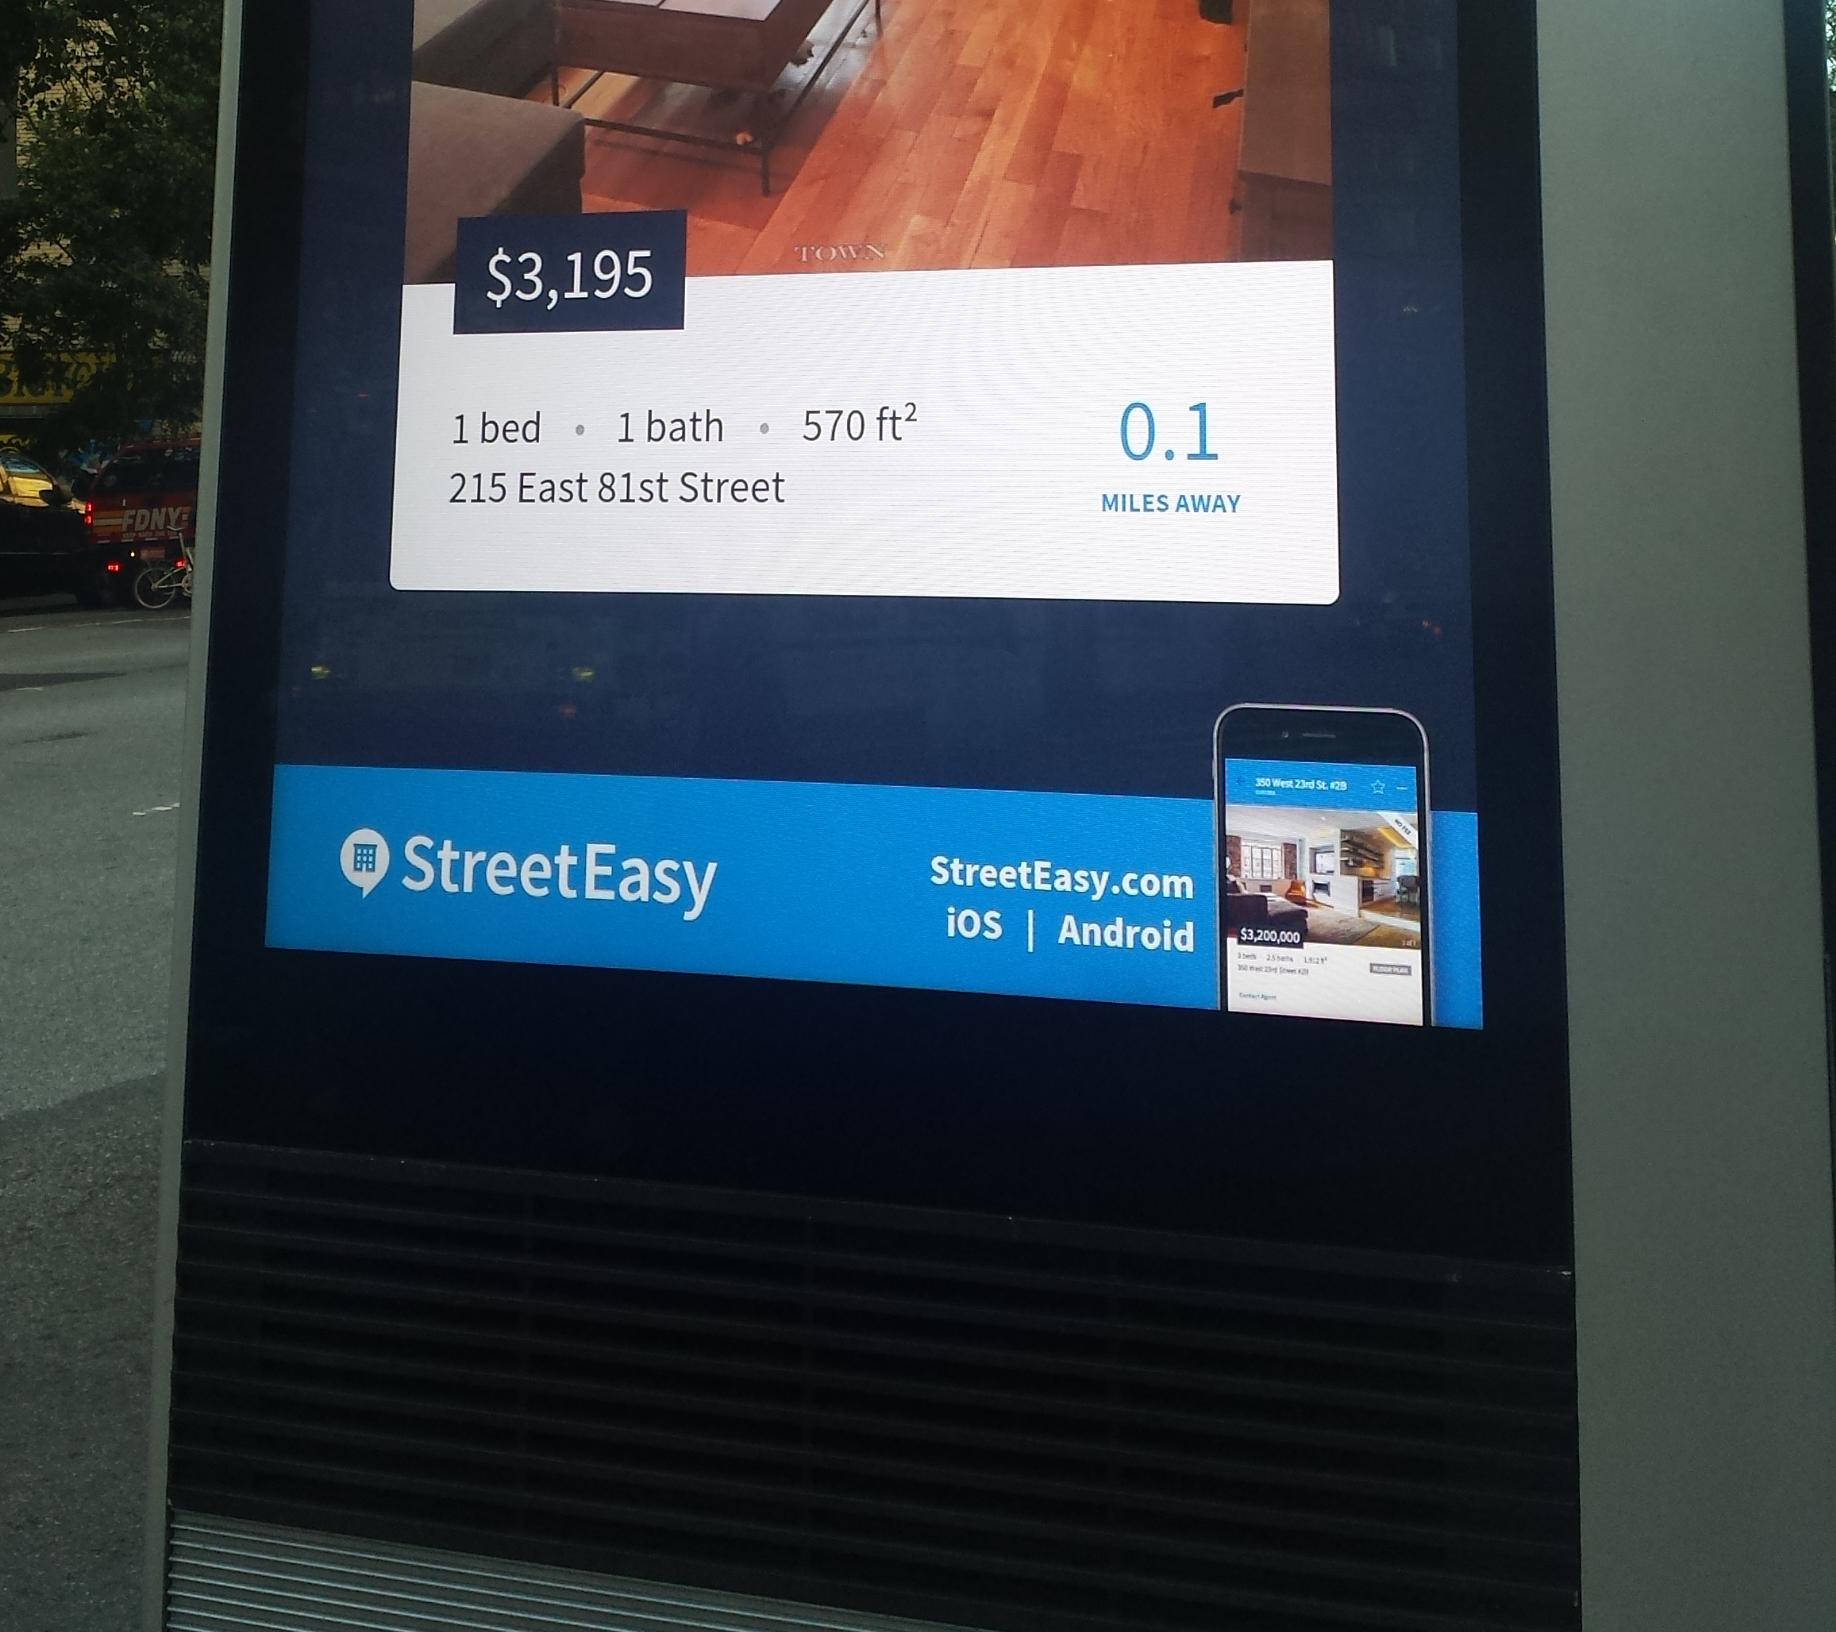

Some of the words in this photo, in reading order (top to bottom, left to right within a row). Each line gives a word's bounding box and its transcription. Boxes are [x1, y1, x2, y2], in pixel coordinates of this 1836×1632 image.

[794, 244, 884, 263] TOWN
[486, 247, 653, 309] $3,195
[452, 414, 469, 444] 1
[481, 411, 541, 444] bed
[618, 412, 635, 443] 1
[647, 409, 724, 443] bath
[803, 410, 865, 441] 570
[1120, 402, 1218, 461] 0.1
[449, 472, 507, 503] 215
[518, 472, 589, 503] East
[598, 472, 669, 503] 81st
[679, 471, 786, 503] Street
[1102, 494, 1169, 513] MILES
[1175, 495, 1241, 513] AWAY
[121, 507, 182, 531] FDNY
[1272, 778, 1293, 788] West
[1295, 779, 1315, 789] 23rd
[401, 833, 718, 921] StreetEasy
[930, 855, 1194, 901] StreetEasy.com
[947, 906, 1003, 940] iOS
[1058, 914, 1194, 952] Android
[1240, 927, 1300, 944] $3,200,000
